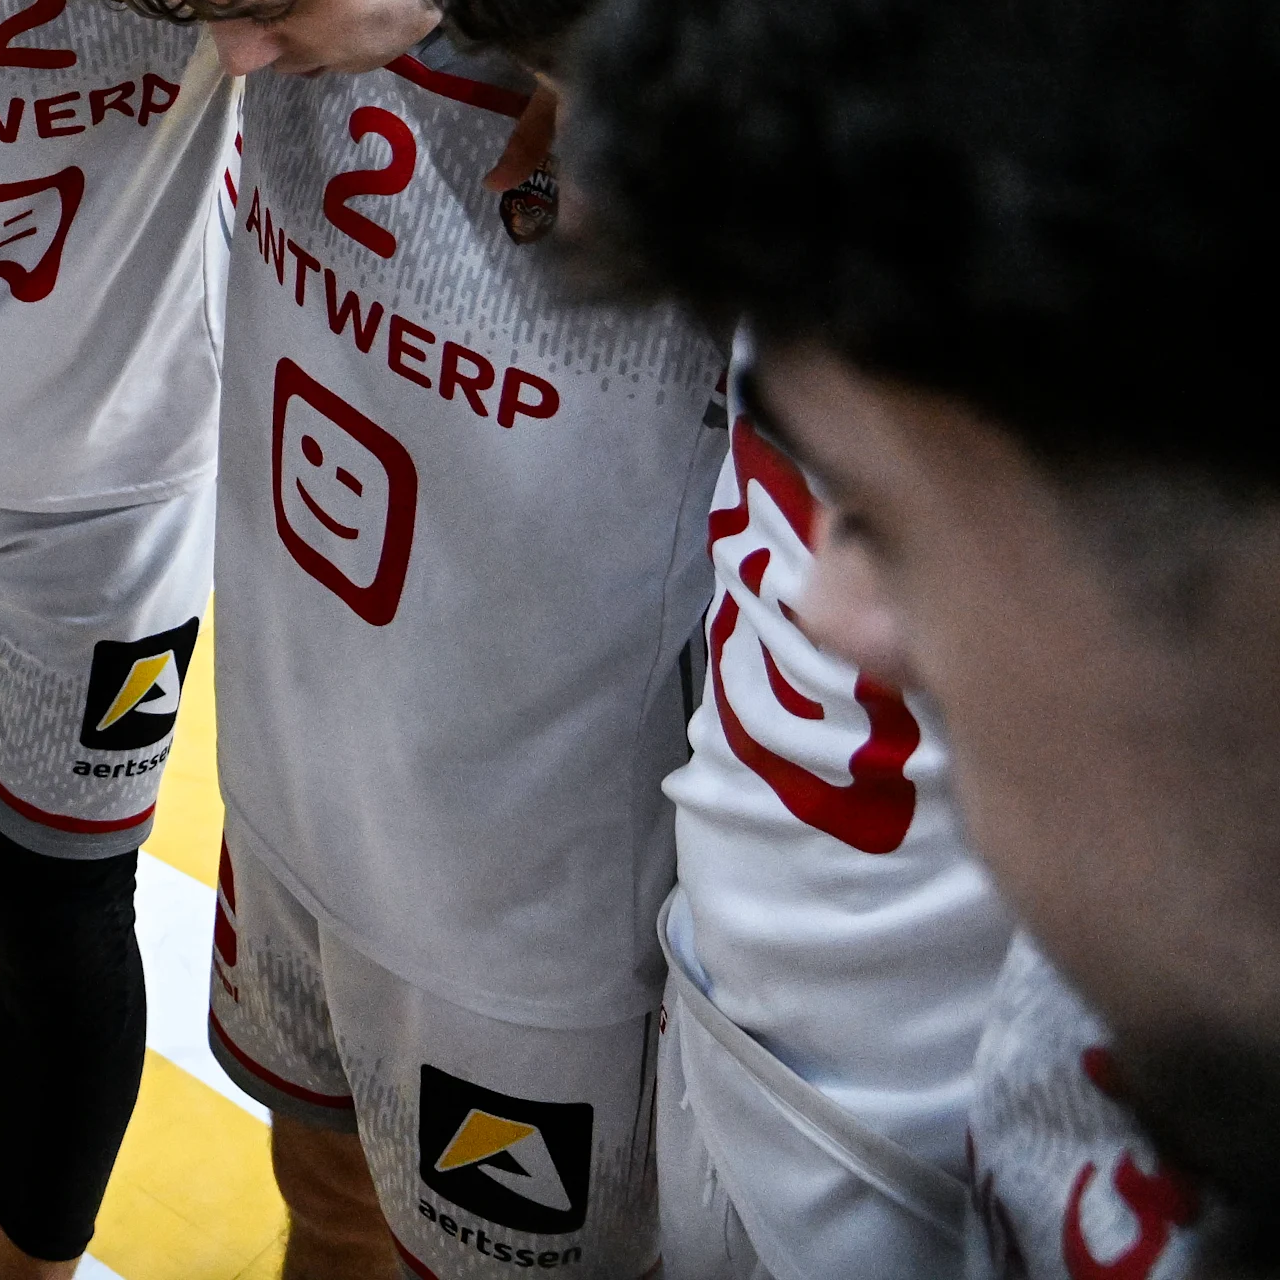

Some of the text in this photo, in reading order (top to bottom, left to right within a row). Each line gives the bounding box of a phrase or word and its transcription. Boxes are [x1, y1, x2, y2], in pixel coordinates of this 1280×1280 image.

[323, 106, 417, 259] 2
[245, 185, 561, 429] ANTWERP
[72, 735, 174, 778] aertsse
[418, 1197, 583, 1269] aertssen
